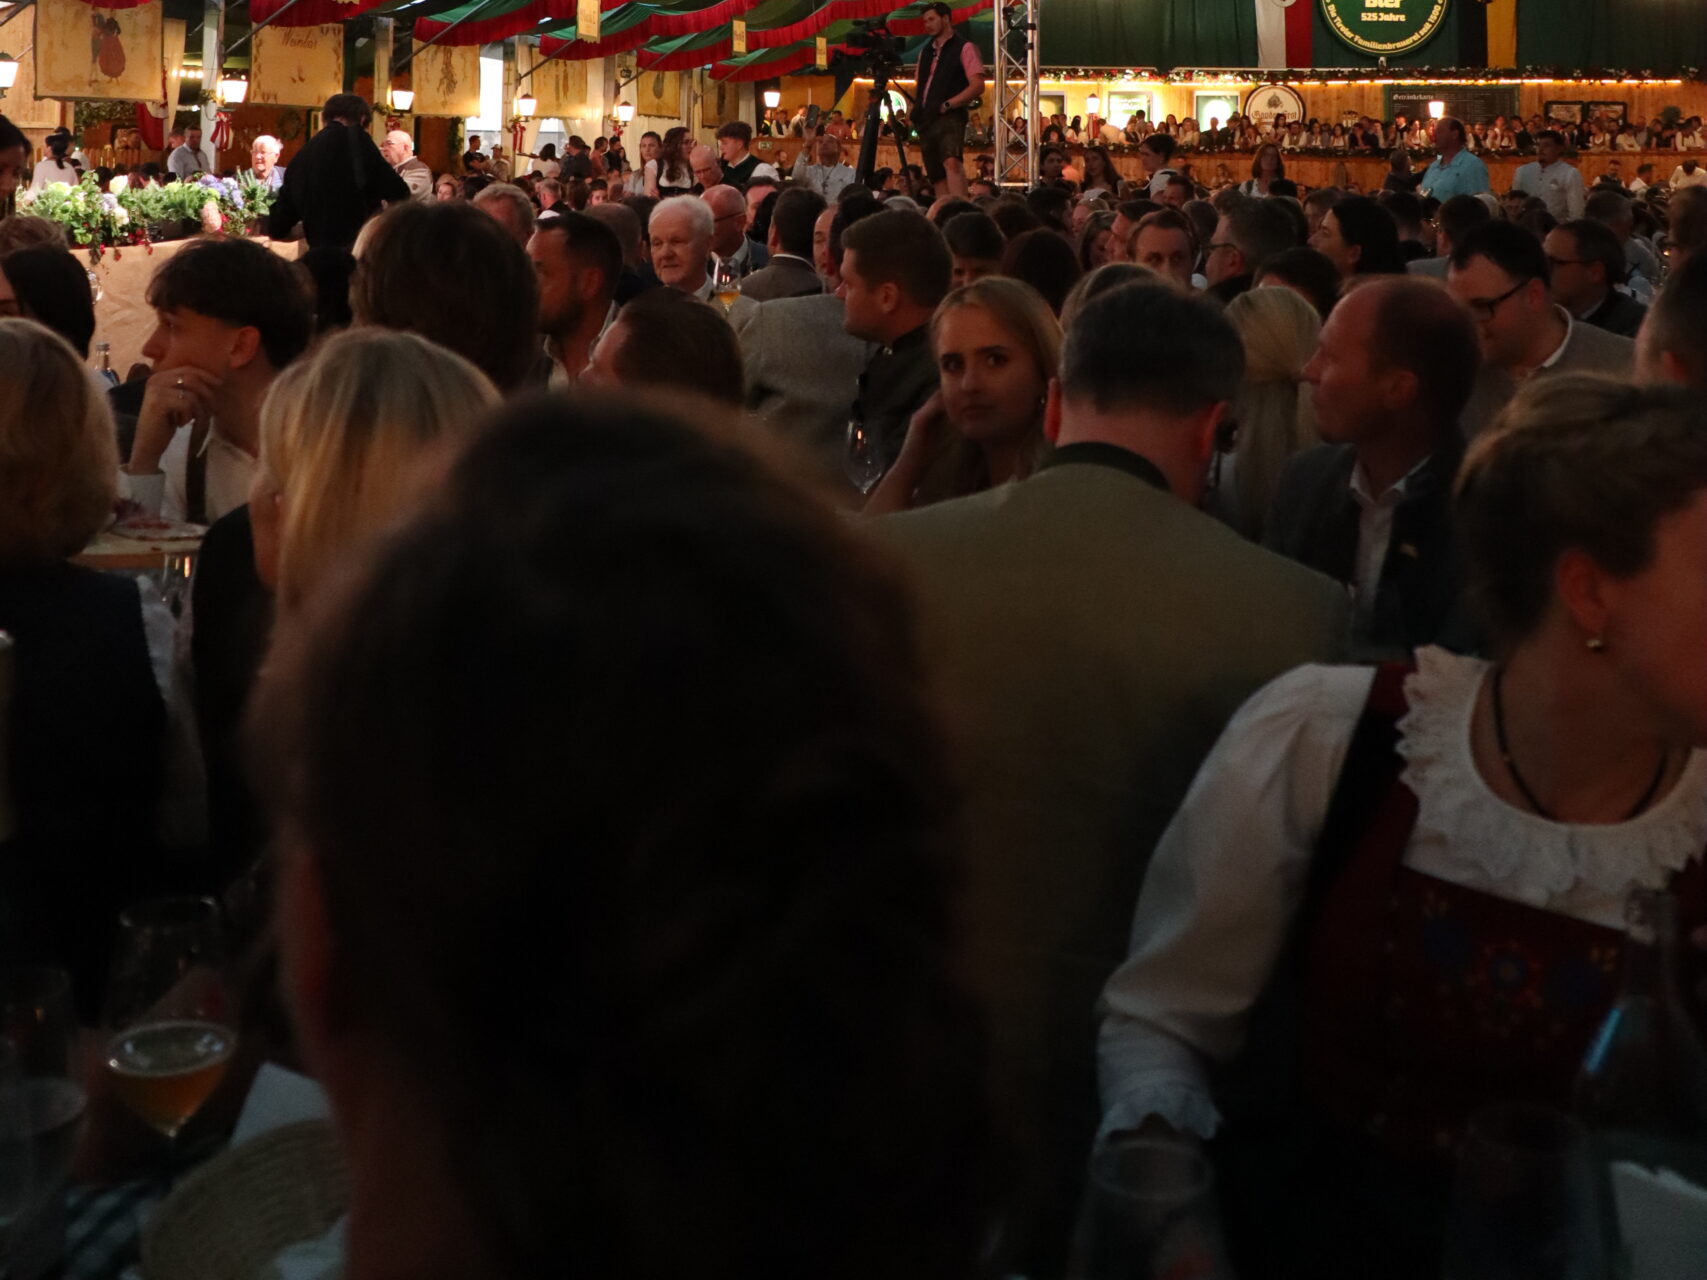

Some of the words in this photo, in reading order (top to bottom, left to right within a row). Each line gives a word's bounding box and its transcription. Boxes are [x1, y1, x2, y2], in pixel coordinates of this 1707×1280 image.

[1327, 4, 1336, 18] Die
[1428, 4, 1441, 23] 1500
[1361, 12, 1378, 21] 525
[1378, 12, 1406, 22] Jahre
